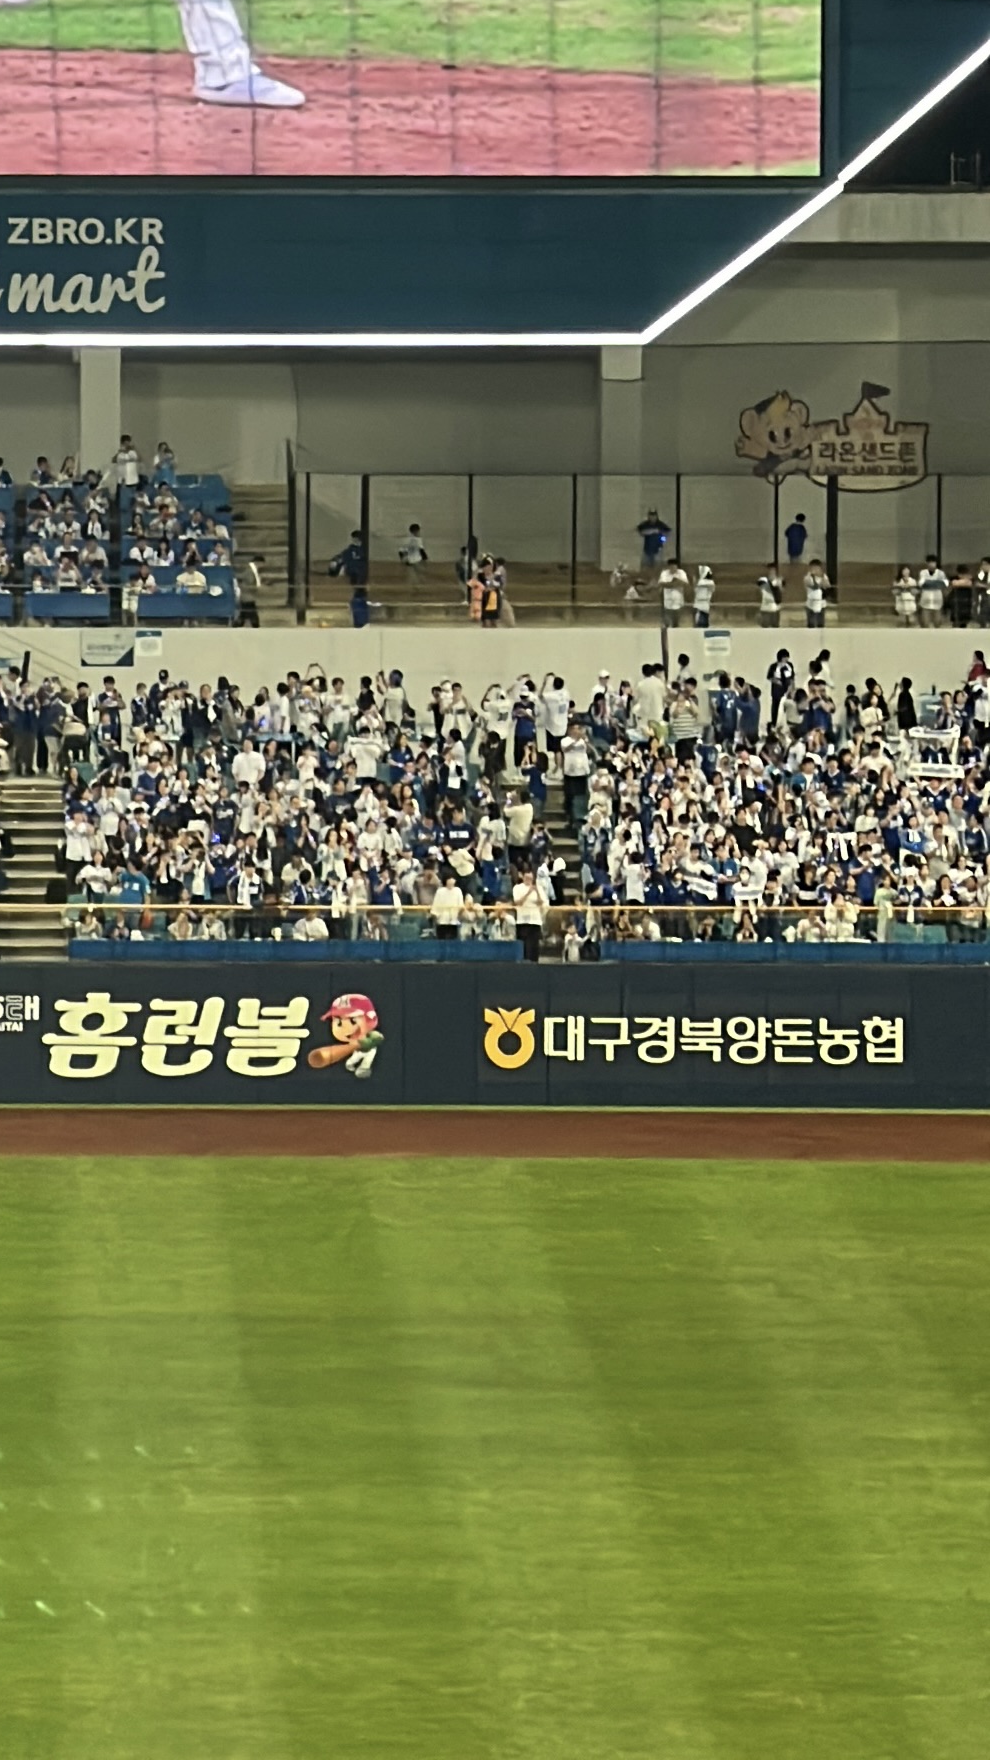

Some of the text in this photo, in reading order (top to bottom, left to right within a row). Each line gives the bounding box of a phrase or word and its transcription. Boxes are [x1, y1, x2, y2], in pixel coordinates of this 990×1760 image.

[8, 217, 164, 245] ZBRO.KR
[8, 245, 166, 313] mart
[41, 992, 310, 1078] 홈런볼
[543, 1015, 904, 1065] 대구경북양돈농협
